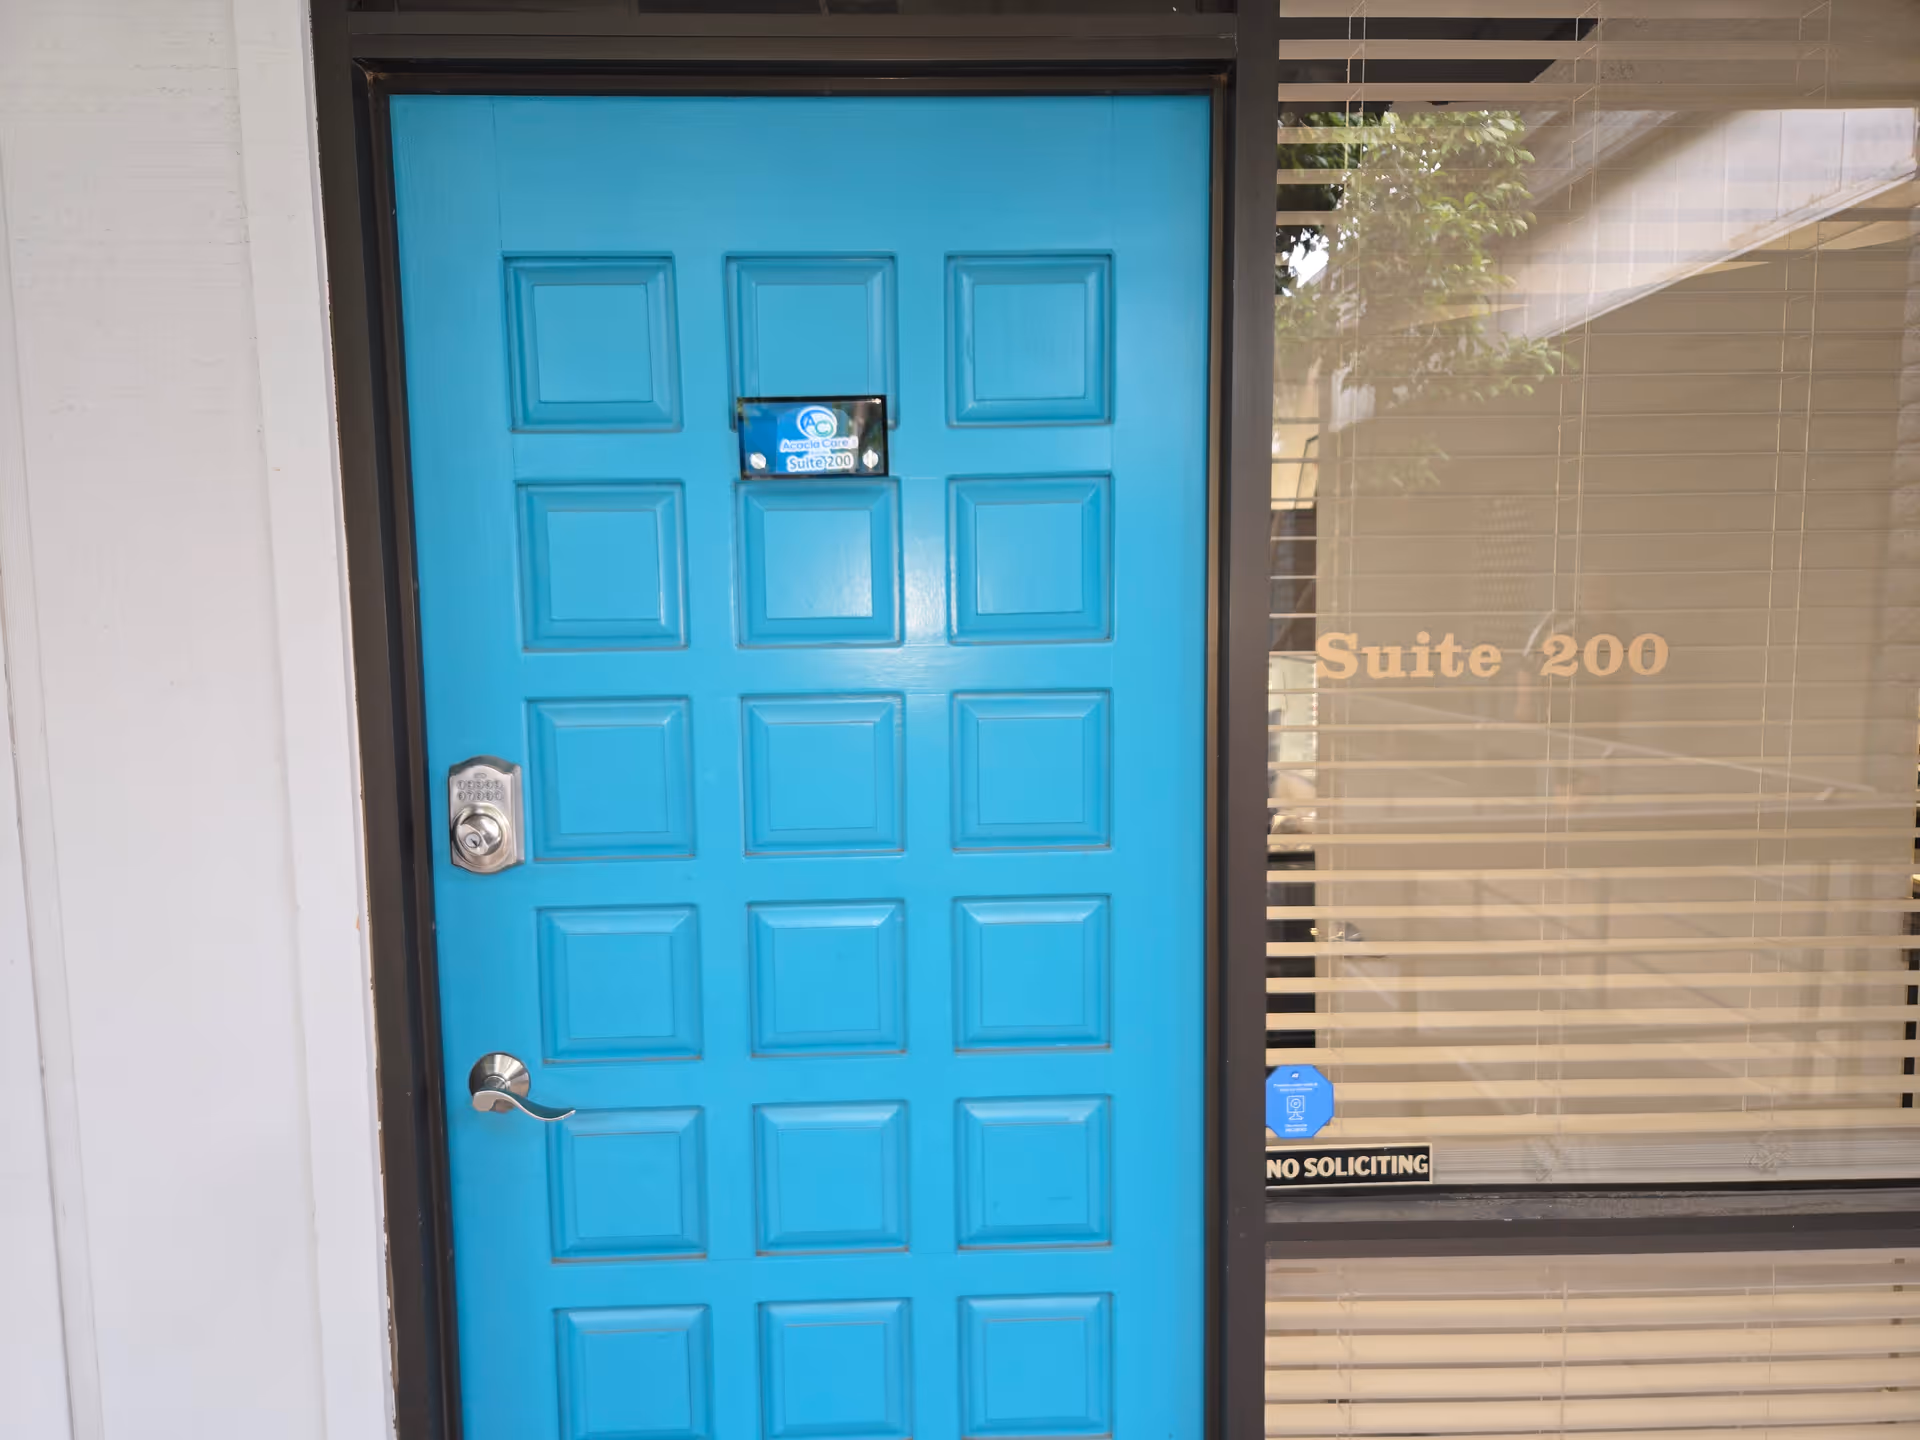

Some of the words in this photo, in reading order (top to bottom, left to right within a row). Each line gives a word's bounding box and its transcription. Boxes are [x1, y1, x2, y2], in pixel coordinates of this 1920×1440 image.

[783, 440, 820, 449] Acacia
[822, 438, 849, 448] Care
[789, 457, 823, 470] Suite
[828, 455, 851, 467] 200
[1316, 631, 1502, 679] Suite
[1540, 633, 1669, 676] 200
[1266, 1158, 1300, 1179] NO
[1304, 1154, 1429, 1177] SOLICITING
